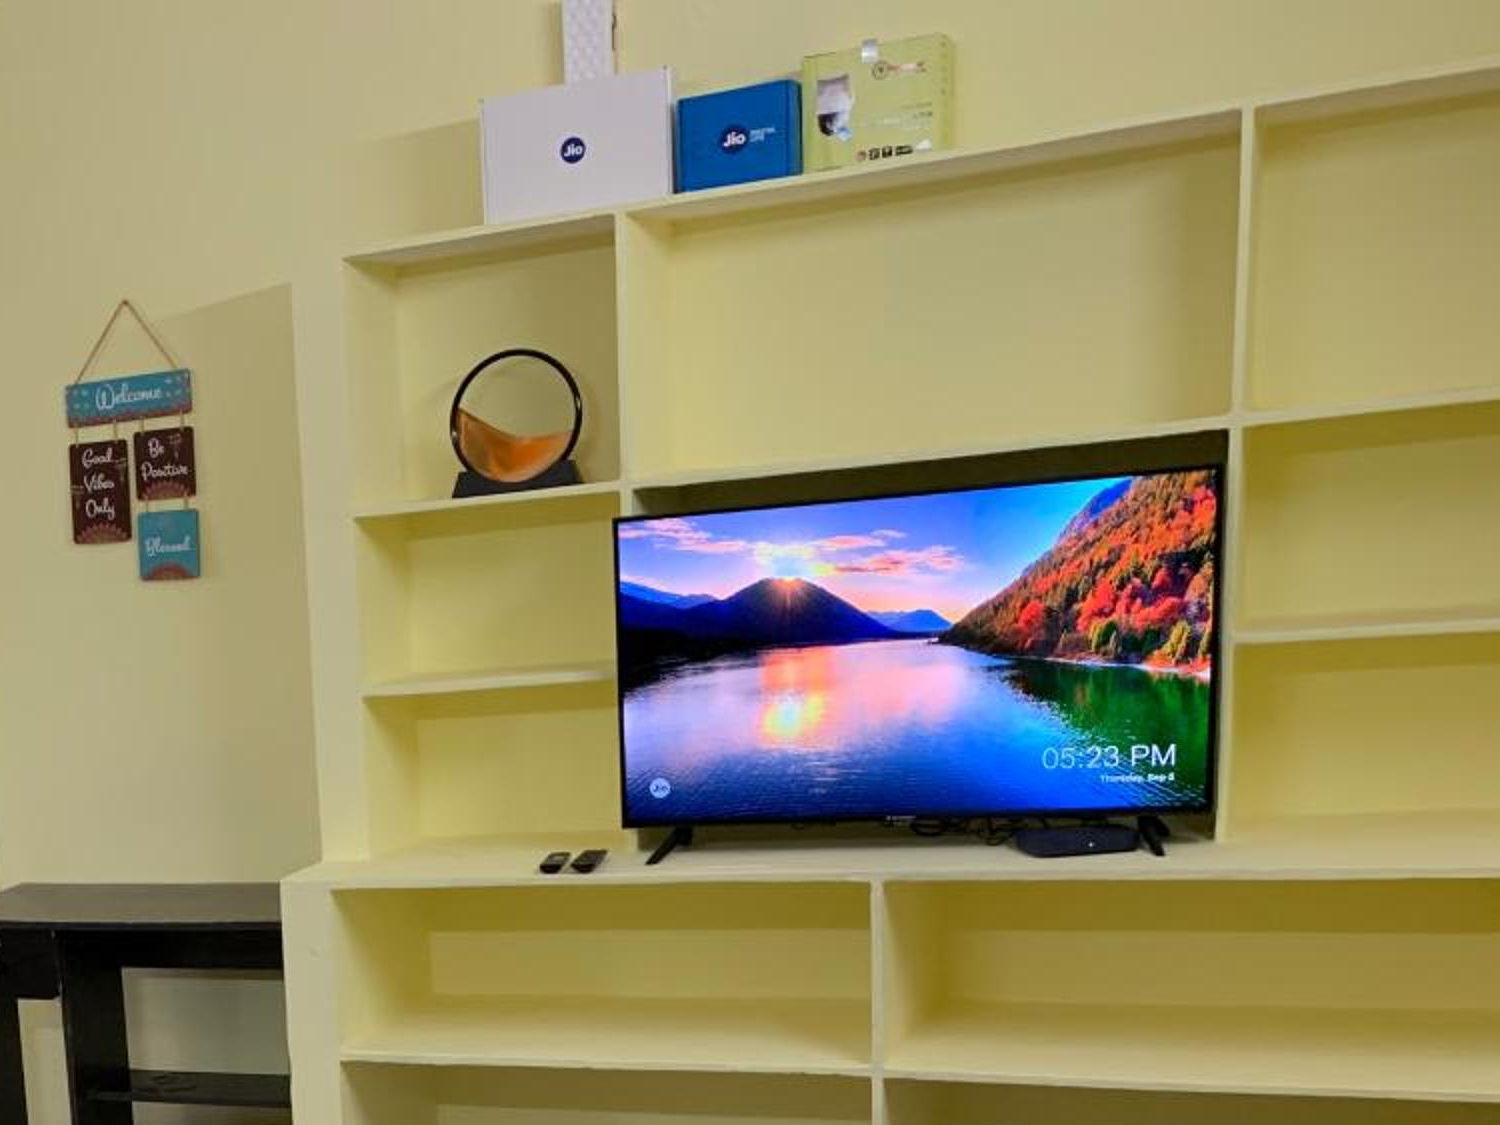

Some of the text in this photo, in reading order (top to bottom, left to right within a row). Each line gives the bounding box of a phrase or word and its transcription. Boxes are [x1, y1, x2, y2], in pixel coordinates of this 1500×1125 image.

[563, 143, 583, 157] Jio
[723, 131, 746, 147] Jio
[95, 383, 164, 410] Welcome
[85, 498, 116, 521] Only
[1042, 743, 1176, 769] 05:23 PM
